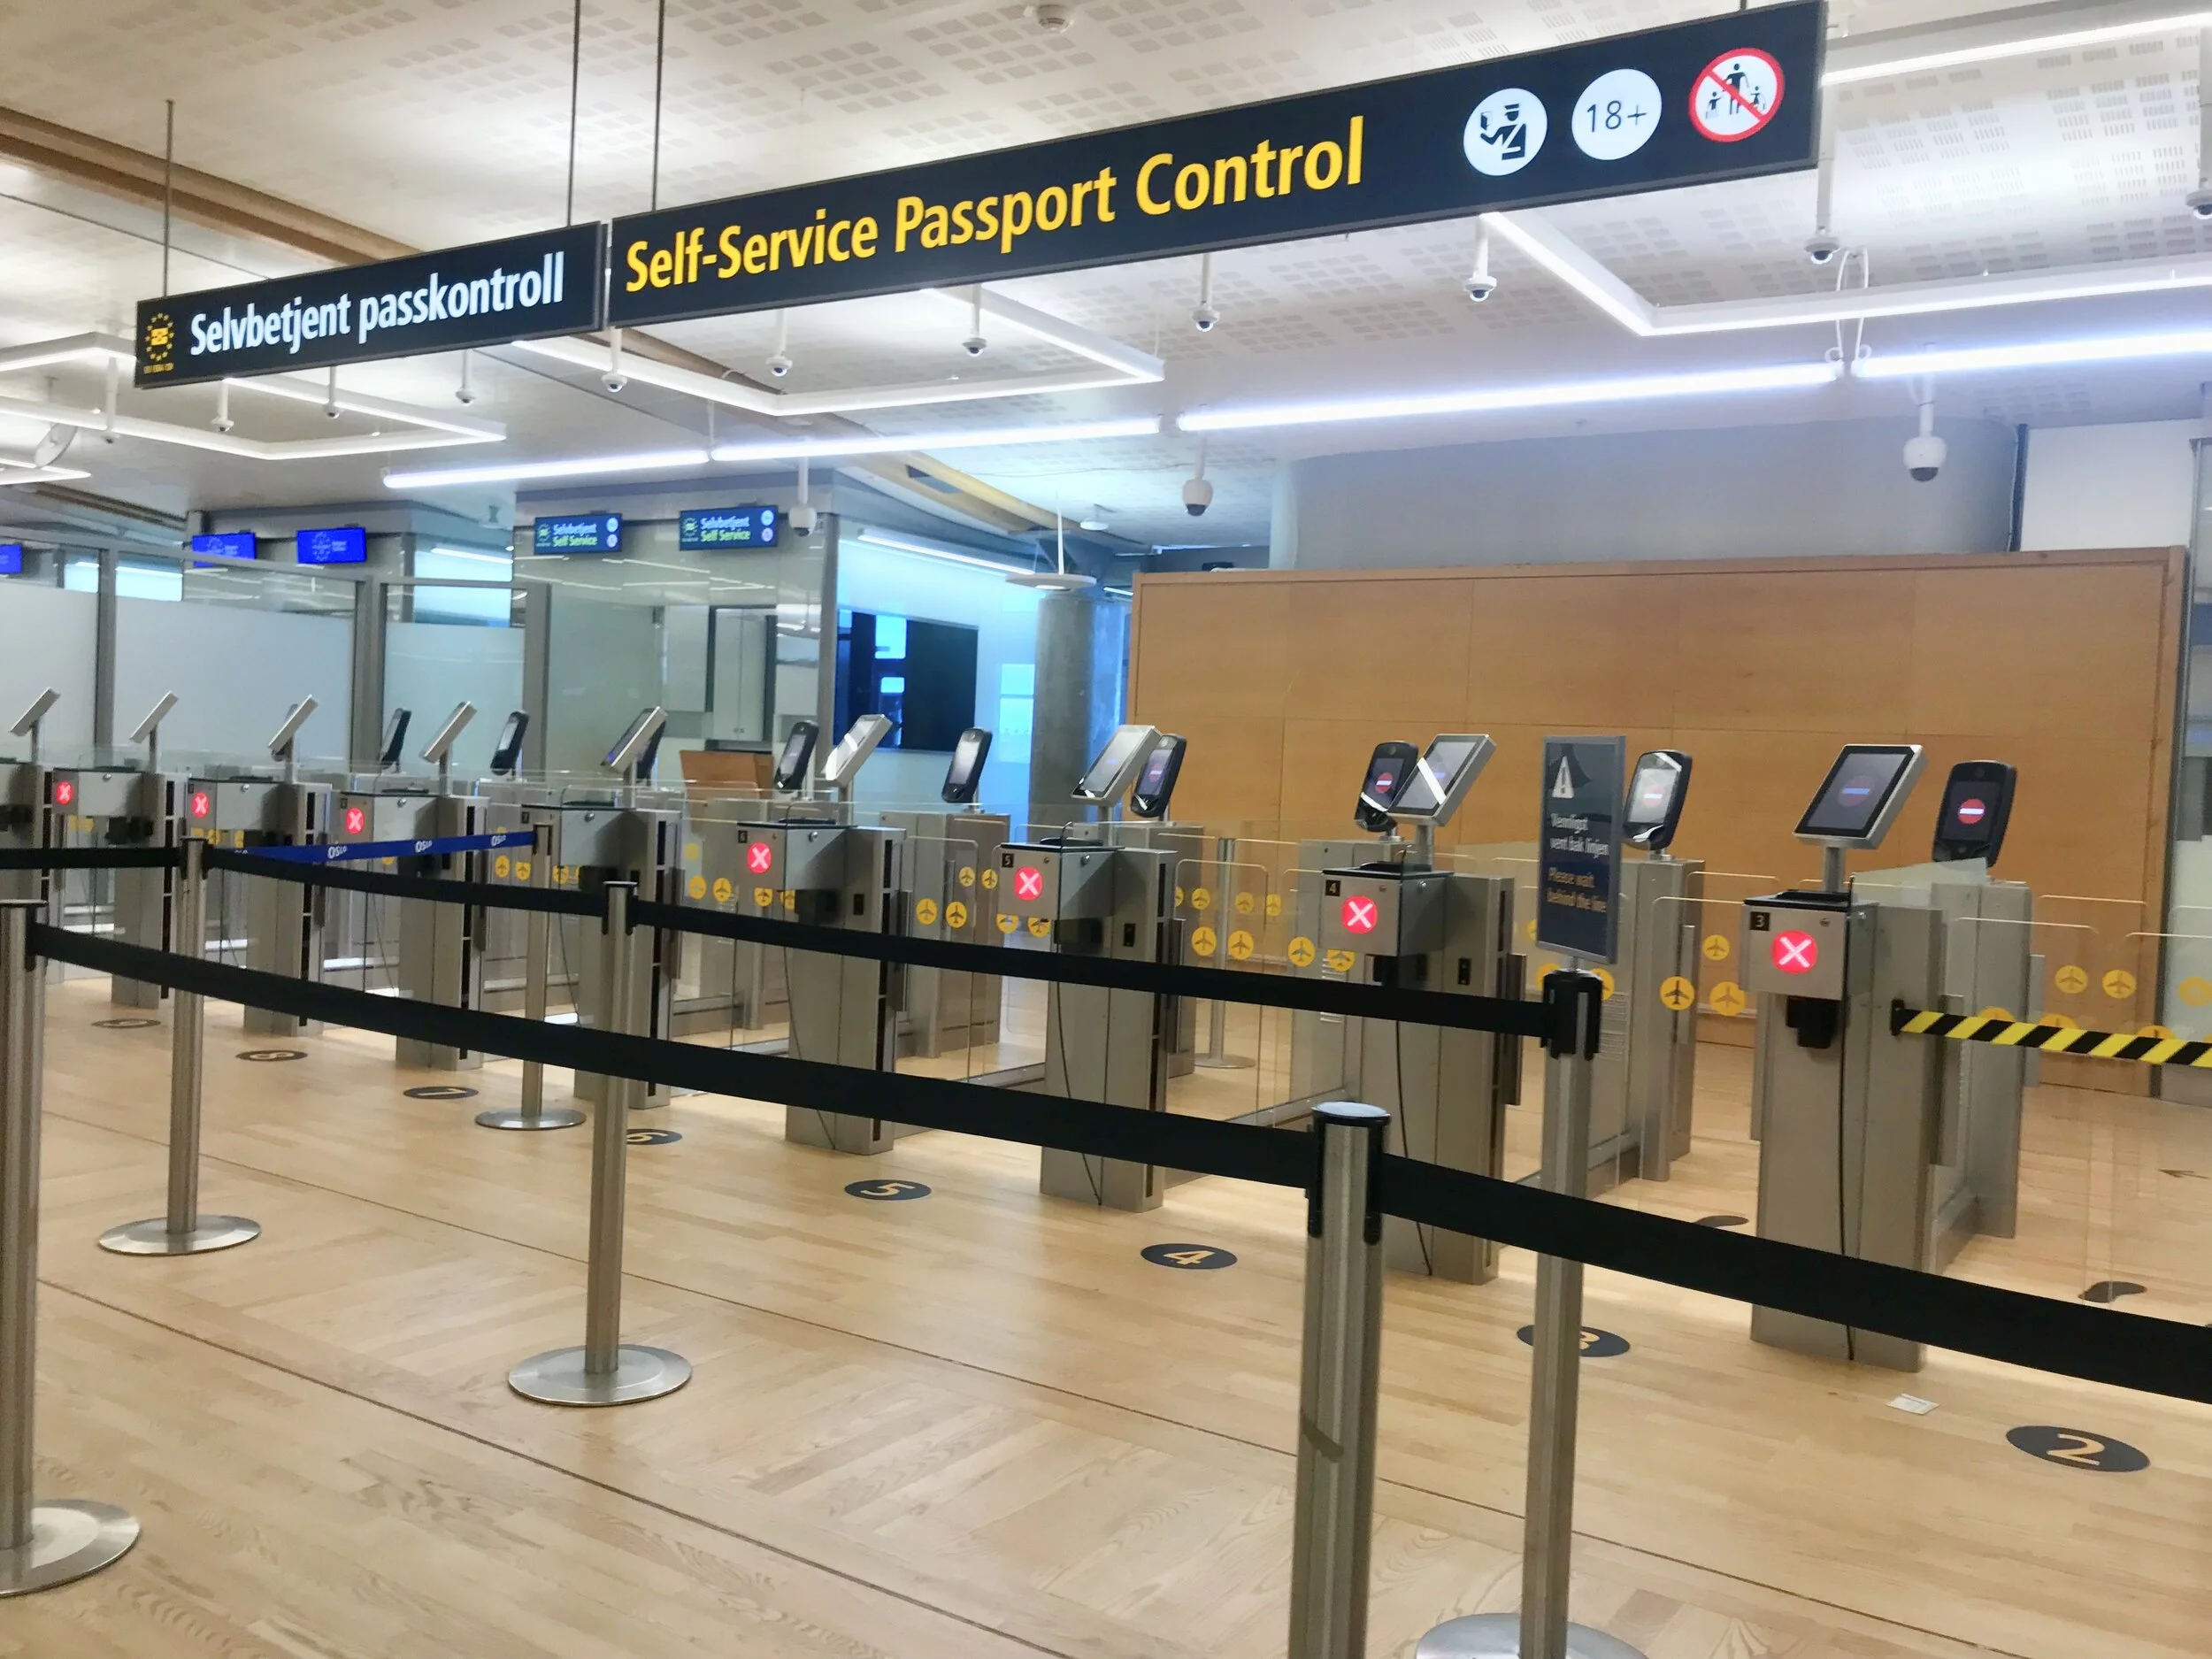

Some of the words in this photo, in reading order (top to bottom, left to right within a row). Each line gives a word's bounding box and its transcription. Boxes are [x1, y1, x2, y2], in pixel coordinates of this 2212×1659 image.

[1586, 100, 1647, 133] 18+
[626, 208, 879, 292] Self-Service
[895, 166, 1118, 254] Passport
[1135, 115, 1363, 215] Control
[190, 293, 351, 356] Selvbetjent
[358, 251, 565, 344] passkontroll
[1755, 915, 1765, 927] 3
[249, 1051, 295, 1060] 8
[417, 1087, 468, 1096] 7
[860, 1182, 916, 1196] 5
[1163, 1250, 1216, 1265] 4
[2046, 1432, 2106, 1466] 2
